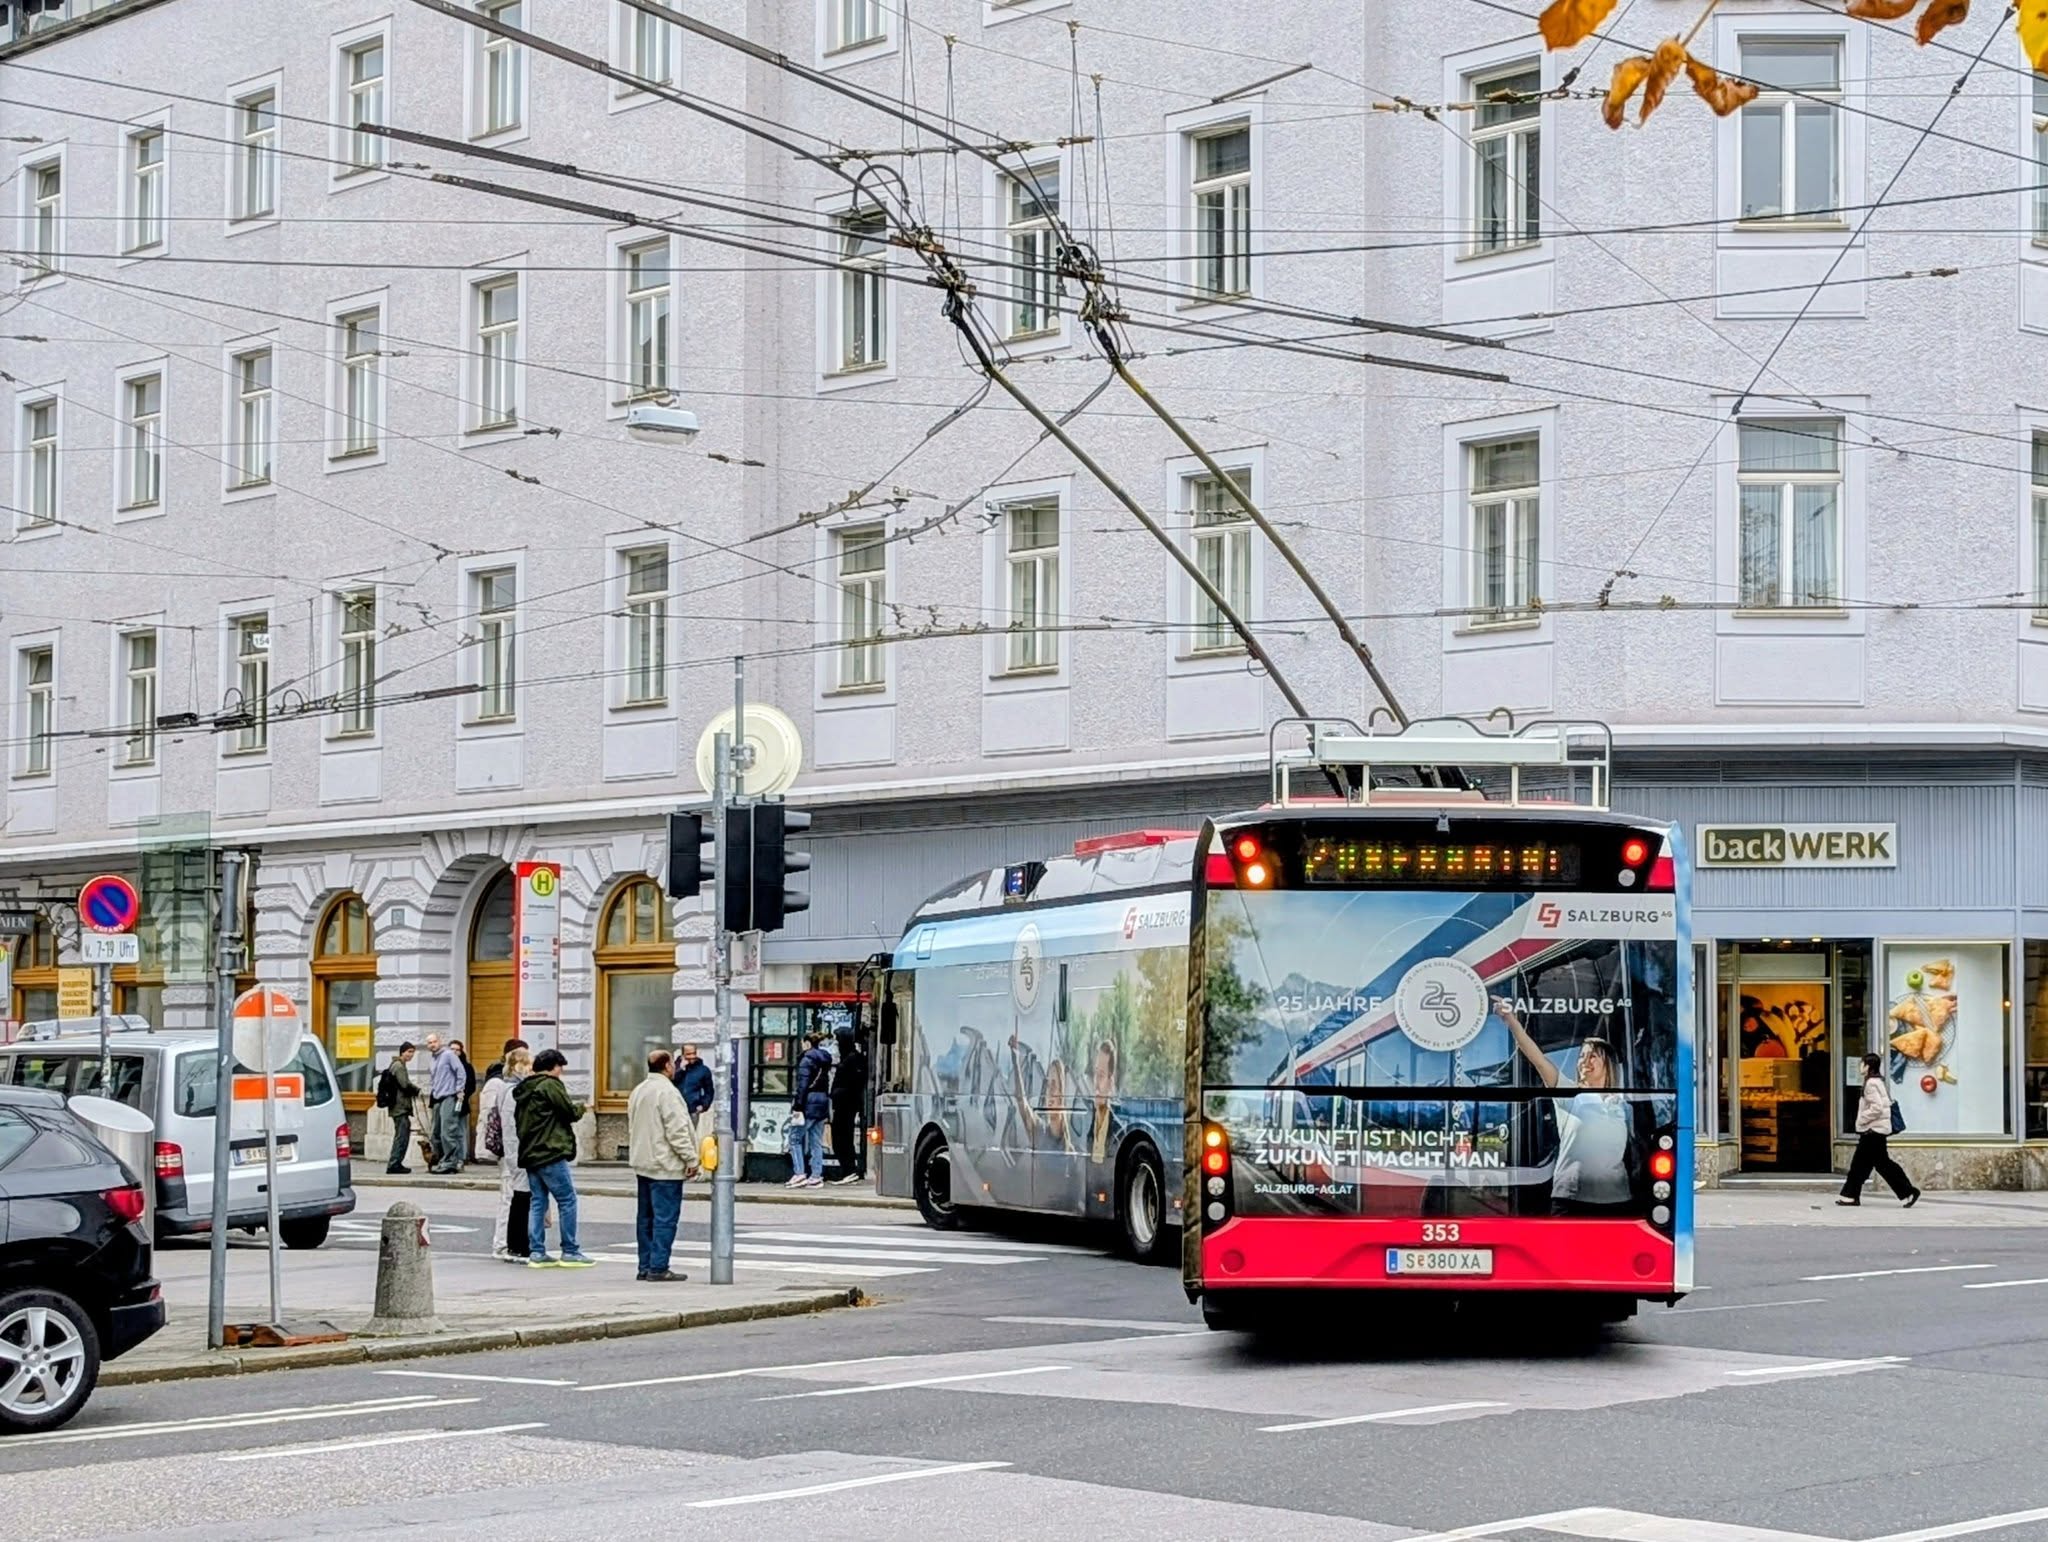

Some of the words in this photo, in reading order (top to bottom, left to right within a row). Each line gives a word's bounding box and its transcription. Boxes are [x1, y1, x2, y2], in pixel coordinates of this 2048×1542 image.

[537, 874, 549, 891] H
[1138, 909, 1185, 929] SALZBURG
[1567, 909, 1659, 922] SALZBURG
[1661, 910, 1673, 918] AG
[119, 940, 135, 958] Uhr
[1278, 996, 1303, 1011] 25
[1308, 996, 1383, 1012] JAHRE
[1420, 980, 1461, 1028] 25
[1501, 997, 1615, 1014] SALZBURG
[1616, 998, 1632, 1007] AG
[1255, 1129, 1358, 1145] ZUKUNFT
[1363, 1130, 1395, 1146] IST
[1254, 1148, 1360, 1167] ZUKUNFT
[1365, 1150, 1443, 1167] MACHT
[1449, 1151, 1506, 1168] MAN.
[1254, 1183, 1353, 1195] SALZBURG-AG.AT
[1422, 1223, 1460, 1241] 353
